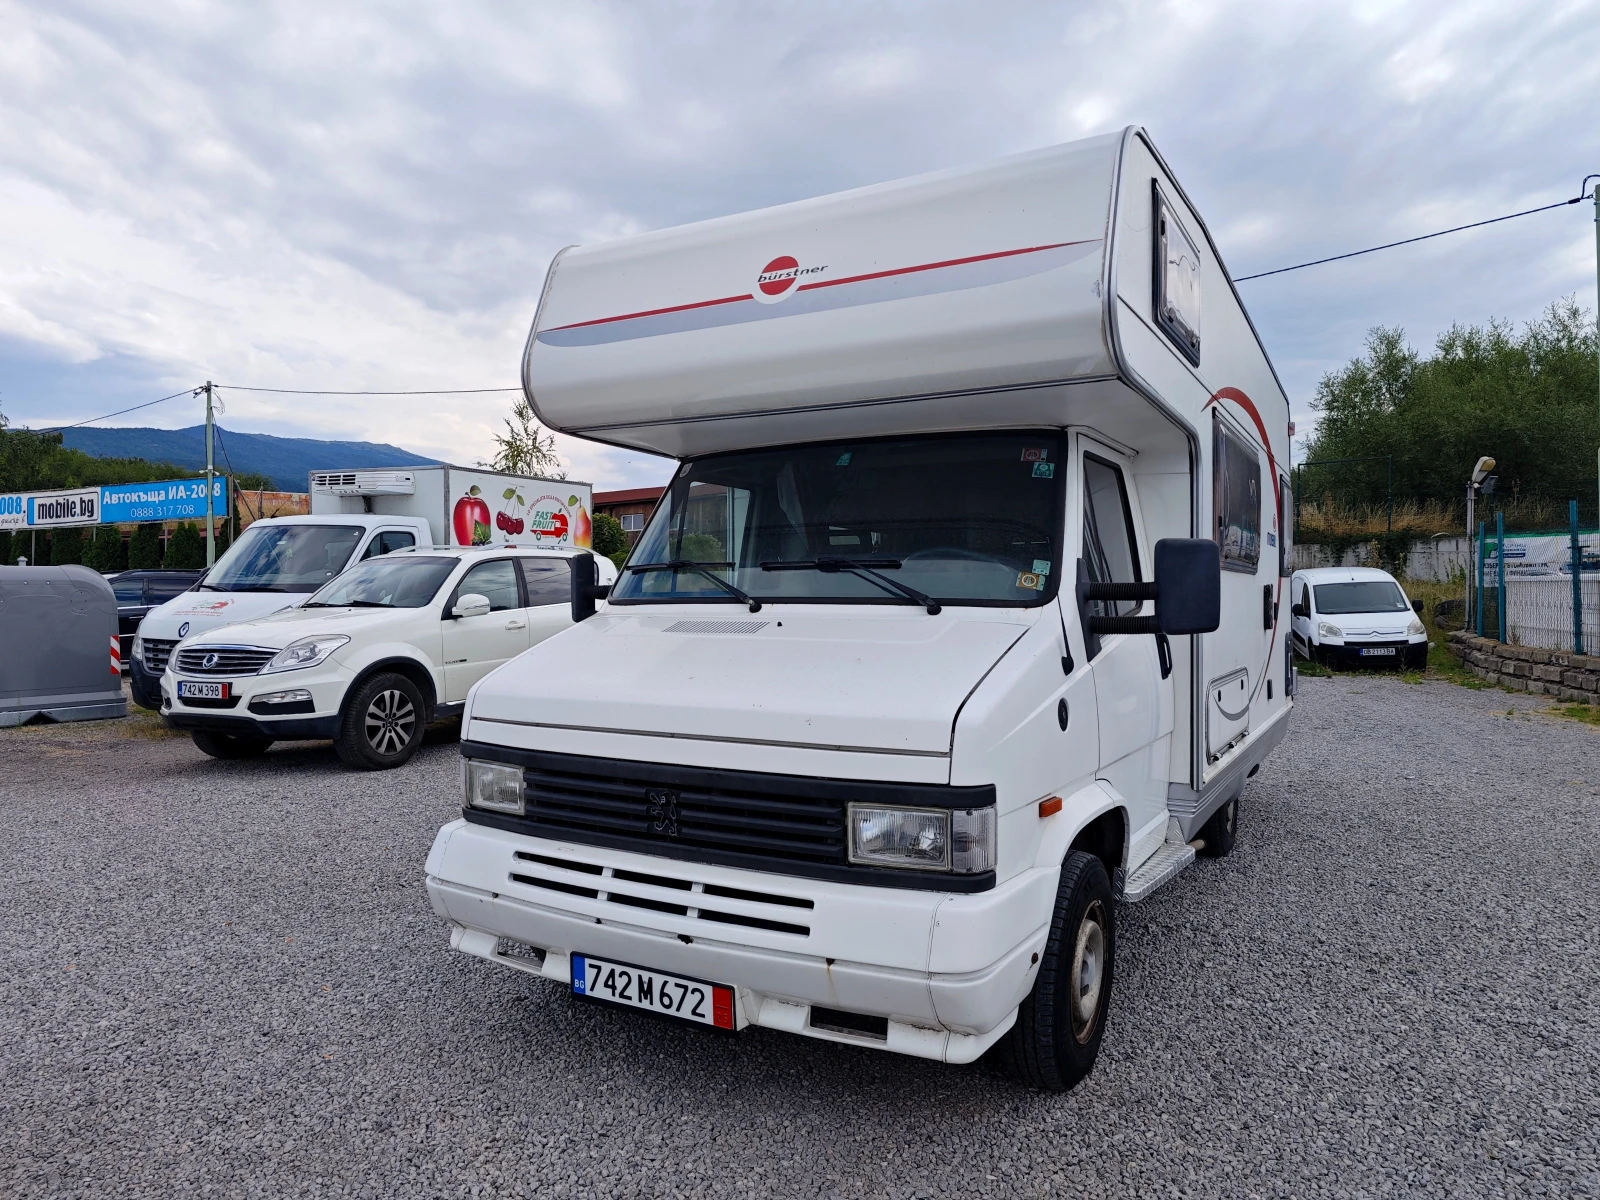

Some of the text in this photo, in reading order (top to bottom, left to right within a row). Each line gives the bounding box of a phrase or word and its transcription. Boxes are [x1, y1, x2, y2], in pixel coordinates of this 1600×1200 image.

[757, 265, 828, 282] bürstner
[103, 483, 221, 504] Автокъща ИА-208
[37, 497, 94, 520] mobile.bg
[130, 504, 195, 518] 0888 317 708
[534, 511, 554, 521] FAST
[531, 520, 555, 530] FRUIT
[574, 979, 585, 989] BG
